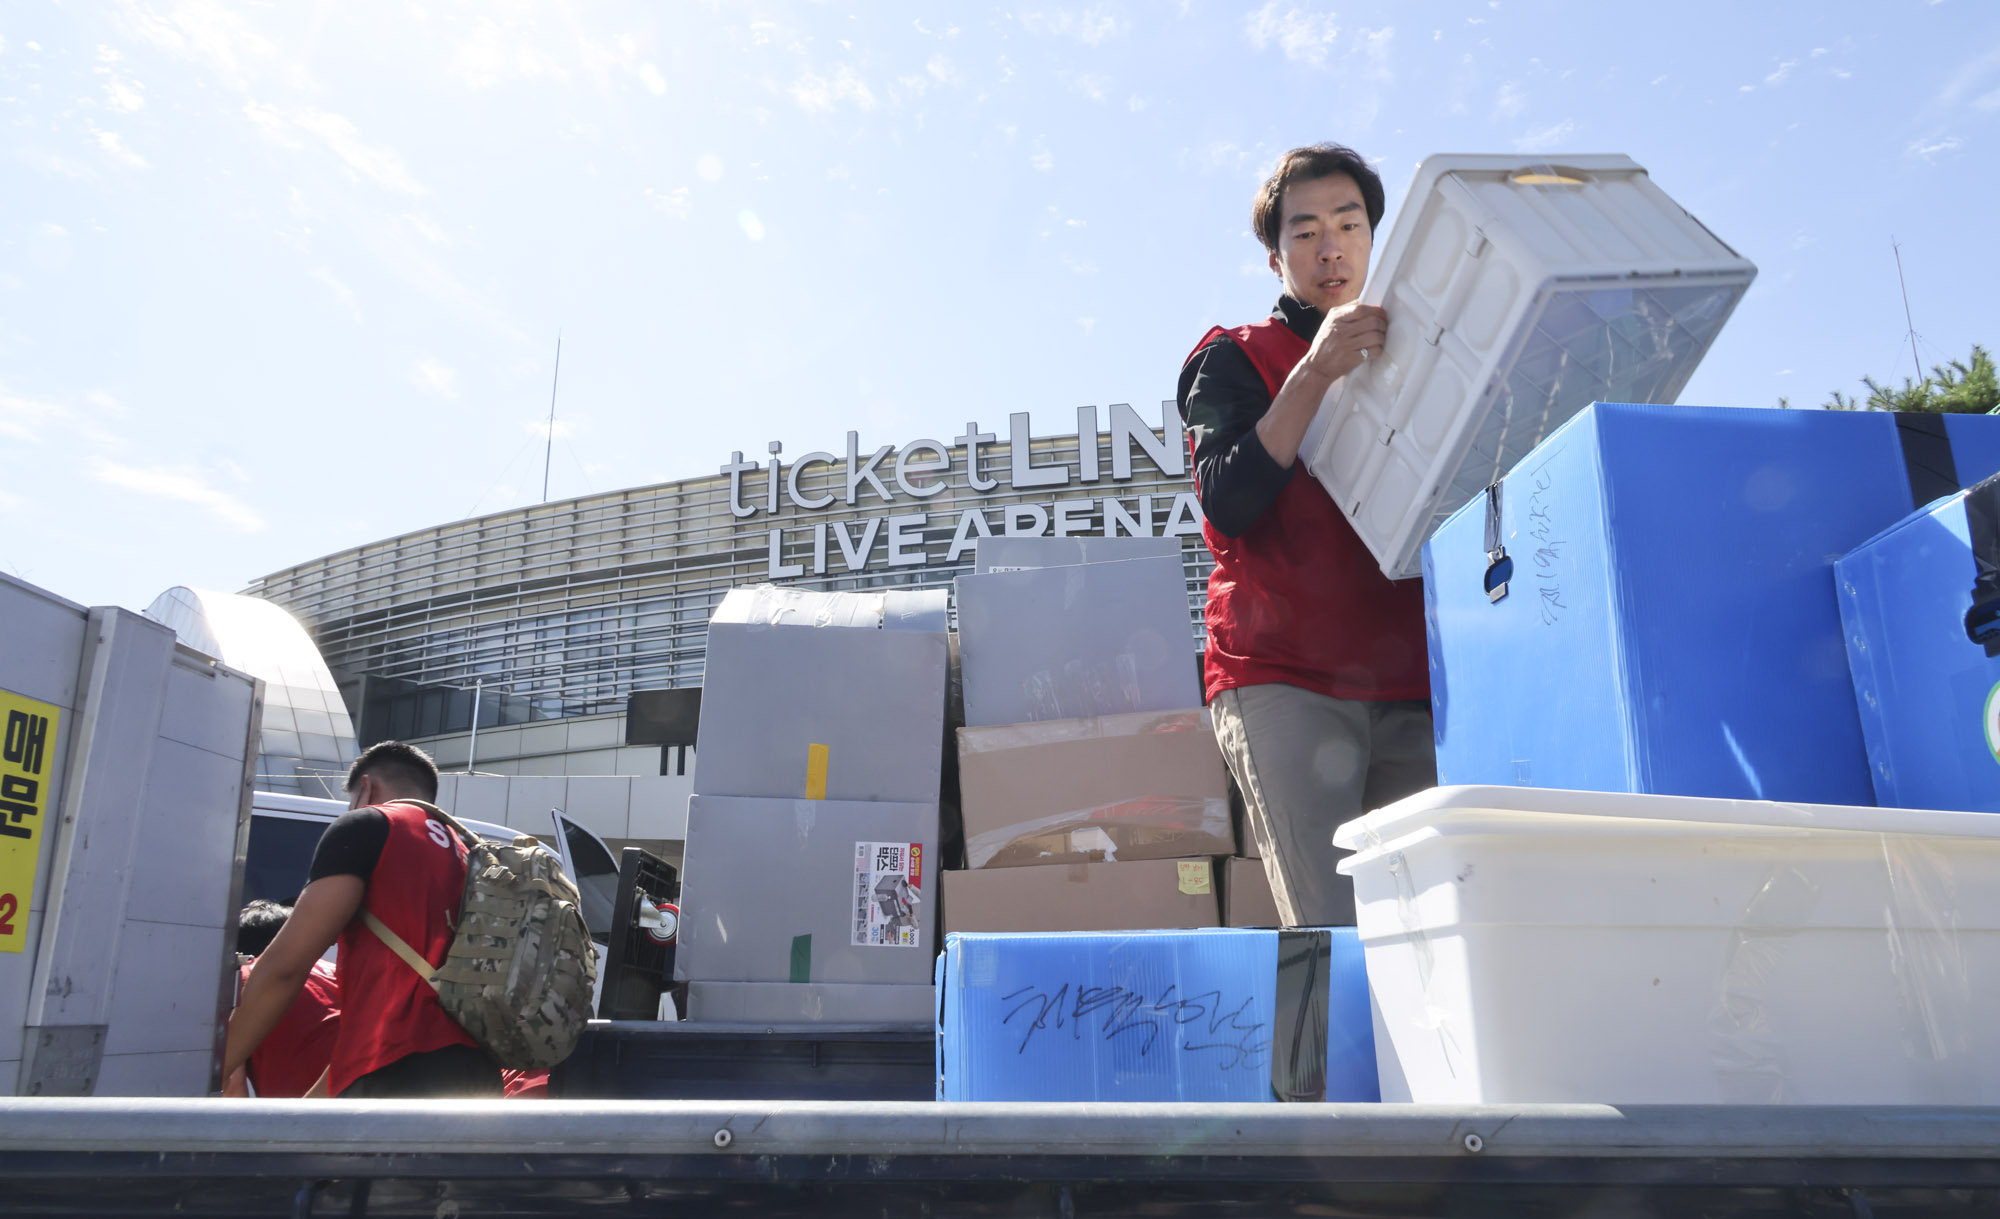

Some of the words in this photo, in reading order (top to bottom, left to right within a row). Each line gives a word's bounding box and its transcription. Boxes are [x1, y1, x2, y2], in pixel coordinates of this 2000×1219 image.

[768, 515, 927, 579] LIVE
[945, 492, 1205, 563] ARENA
[3, 709, 47, 774] 매
[877, 847, 889, 871] 박스
[889, 848, 899, 872] 단프라
[0, 893, 18, 935] 2
